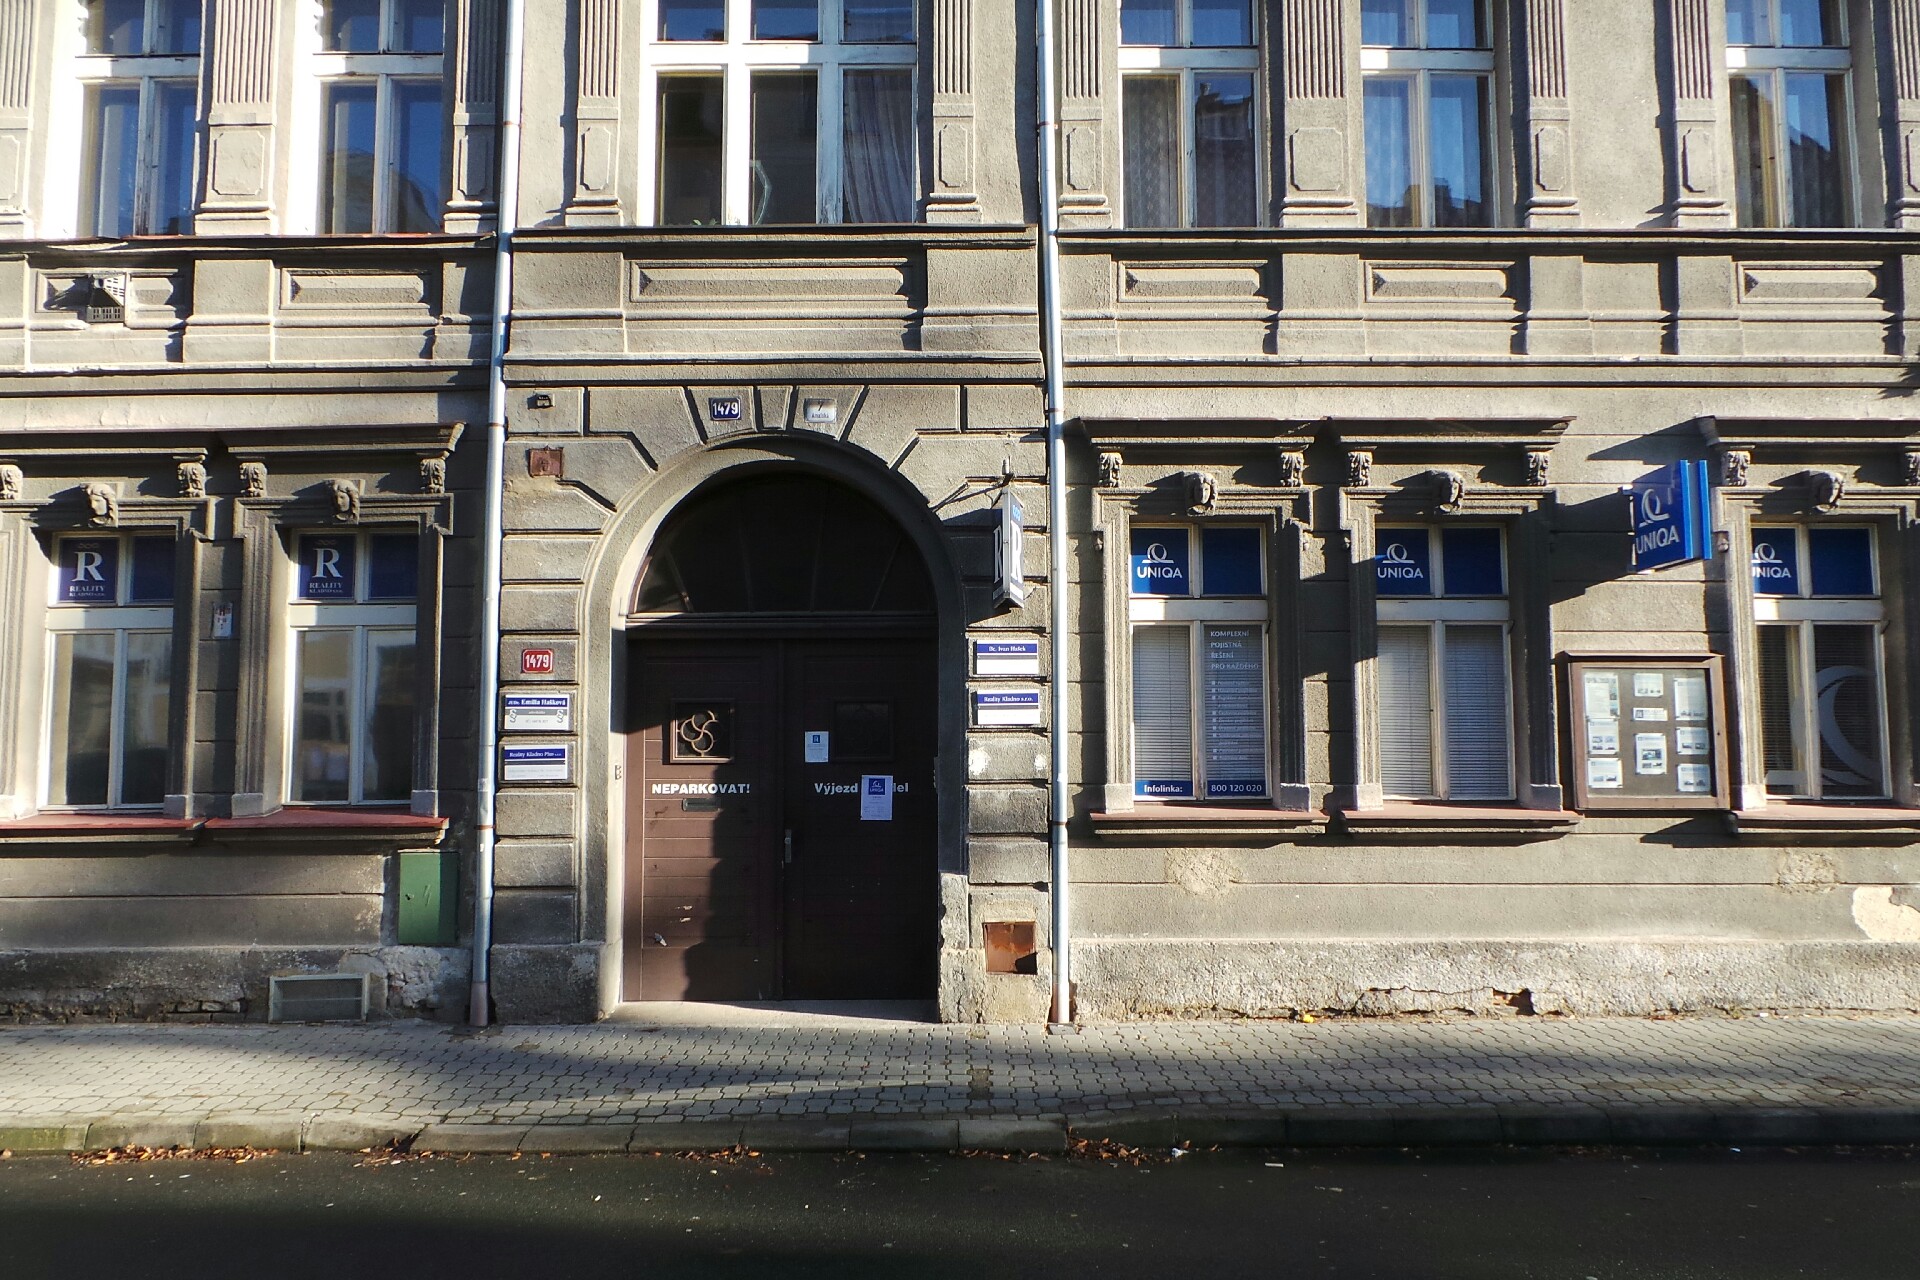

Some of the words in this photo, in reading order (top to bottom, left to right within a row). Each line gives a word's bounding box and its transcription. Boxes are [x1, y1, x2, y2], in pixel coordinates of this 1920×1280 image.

[712, 401, 739, 416] 1479
[1635, 524, 1680, 555] UNIQA
[1010, 519, 1024, 584] R
[71, 551, 105, 582] R
[312, 548, 343, 578] R
[1136, 566, 1183, 579] UNIQA
[1377, 567, 1424, 579] UNIQA
[1210, 629, 1250, 637] KOMPLEXNÍ
[1210, 640, 1242, 649] POJISTNÁ
[525, 654, 550, 668] 1479
[651, 783, 751, 795] NEPARKOVAT!
[814, 782, 859, 795] Výjezd
[1143, 784, 1183, 793] Infolinka:
[1211, 784, 1228, 792] 800
[1230, 784, 1245, 792] 120
[1245, 784, 1262, 792] 020
